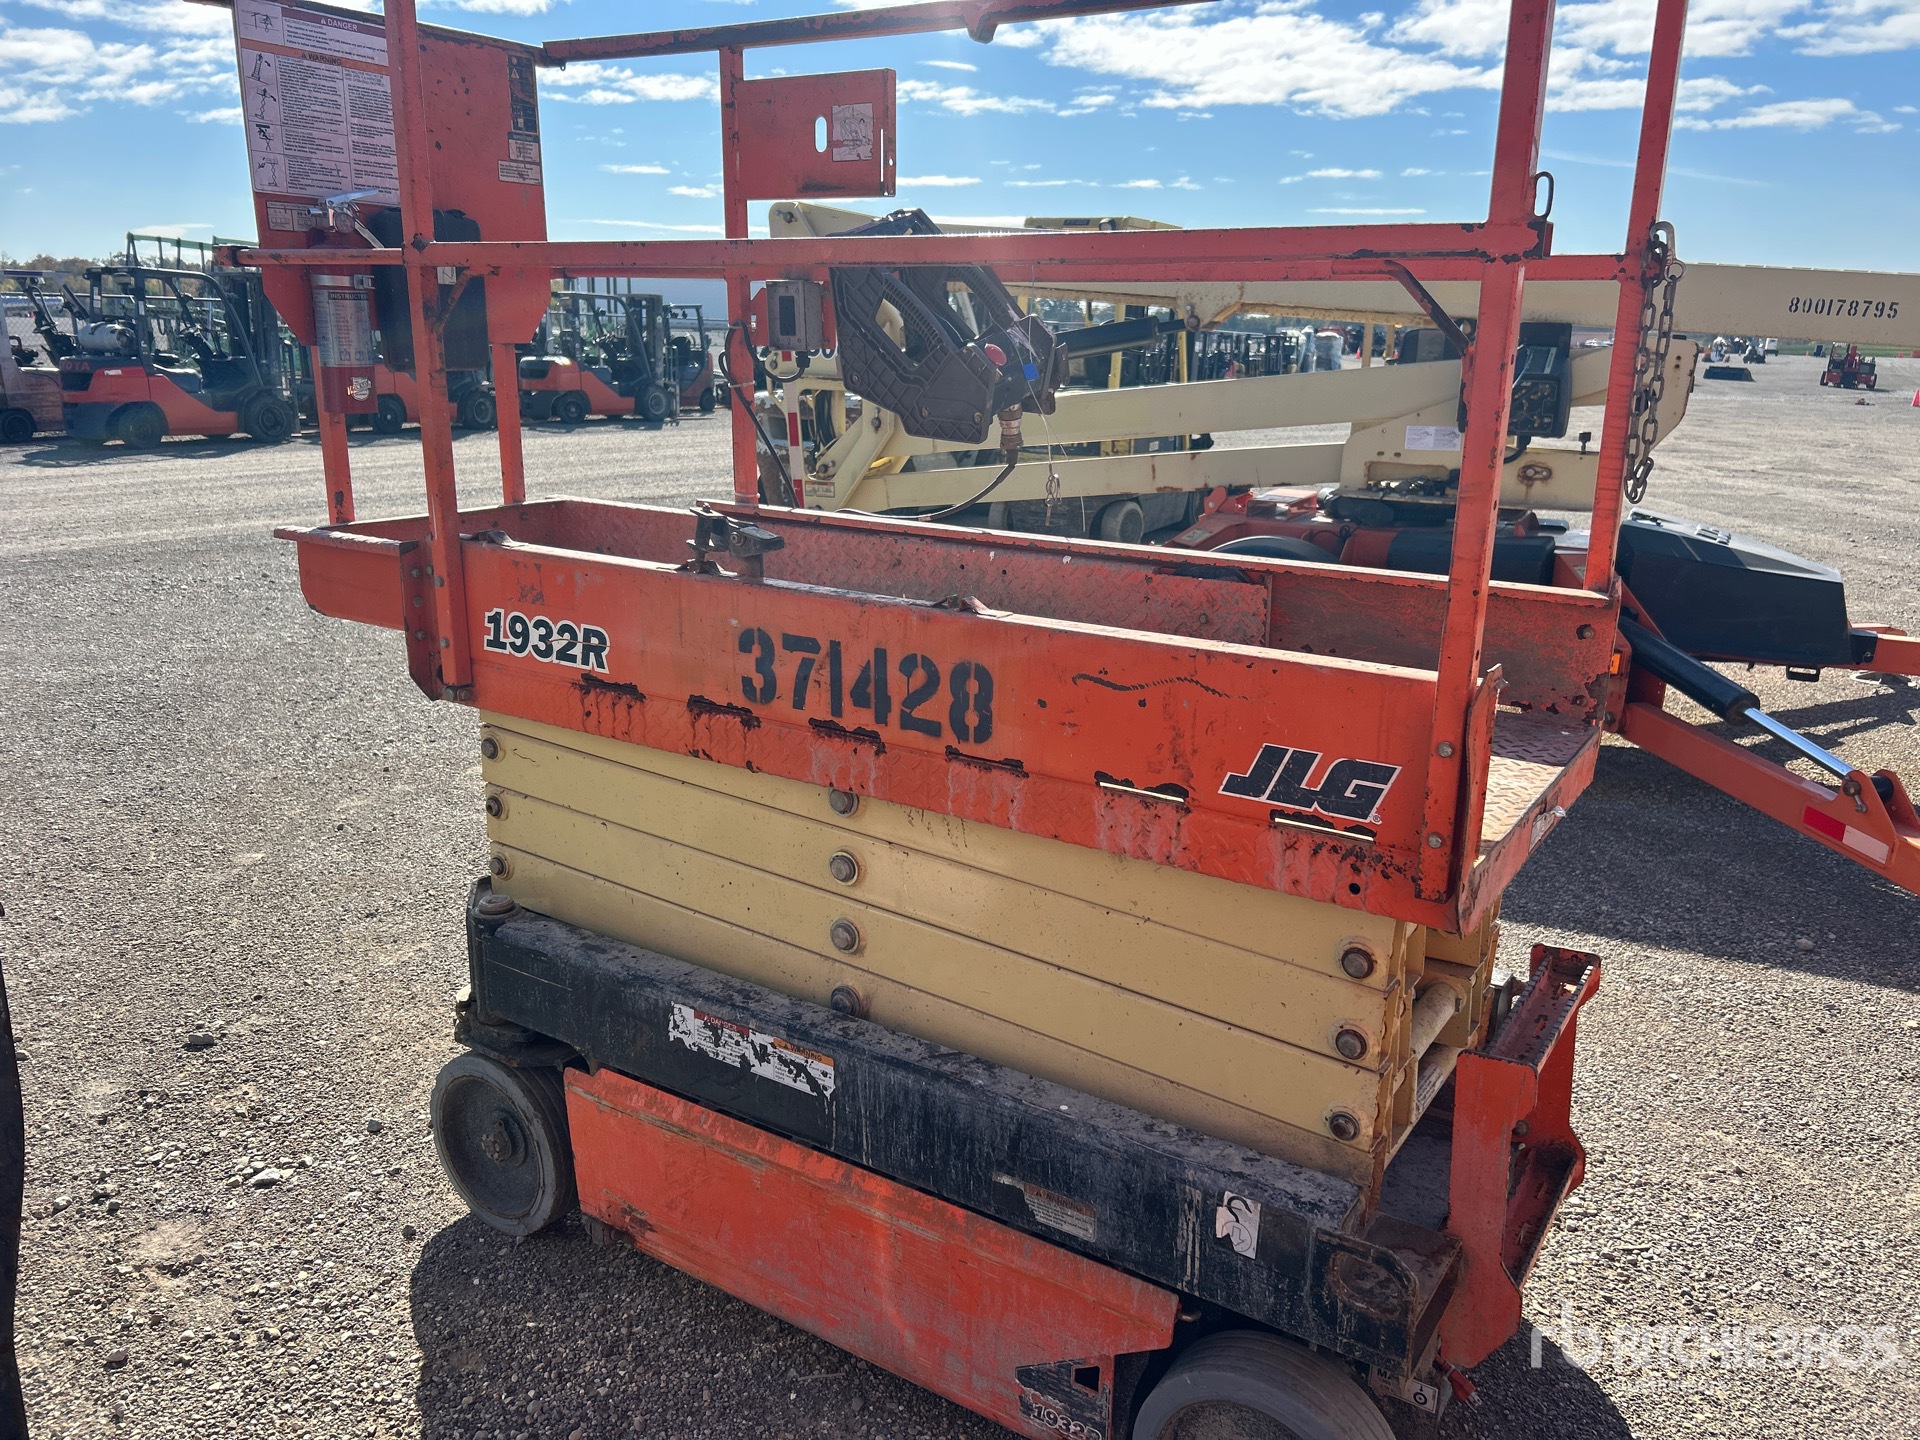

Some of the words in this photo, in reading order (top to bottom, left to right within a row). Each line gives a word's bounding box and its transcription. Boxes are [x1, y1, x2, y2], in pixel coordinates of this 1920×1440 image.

[327, 18, 358, 32] DANGER
[308, 53, 341, 65] WARNING
[329, 292, 367, 300] INSTRUCTI
[1788, 296, 1899, 319] 800178795
[483, 607, 610, 674] 1932R
[738, 627, 994, 744] 371428
[1218, 742, 1402, 823] JLG
